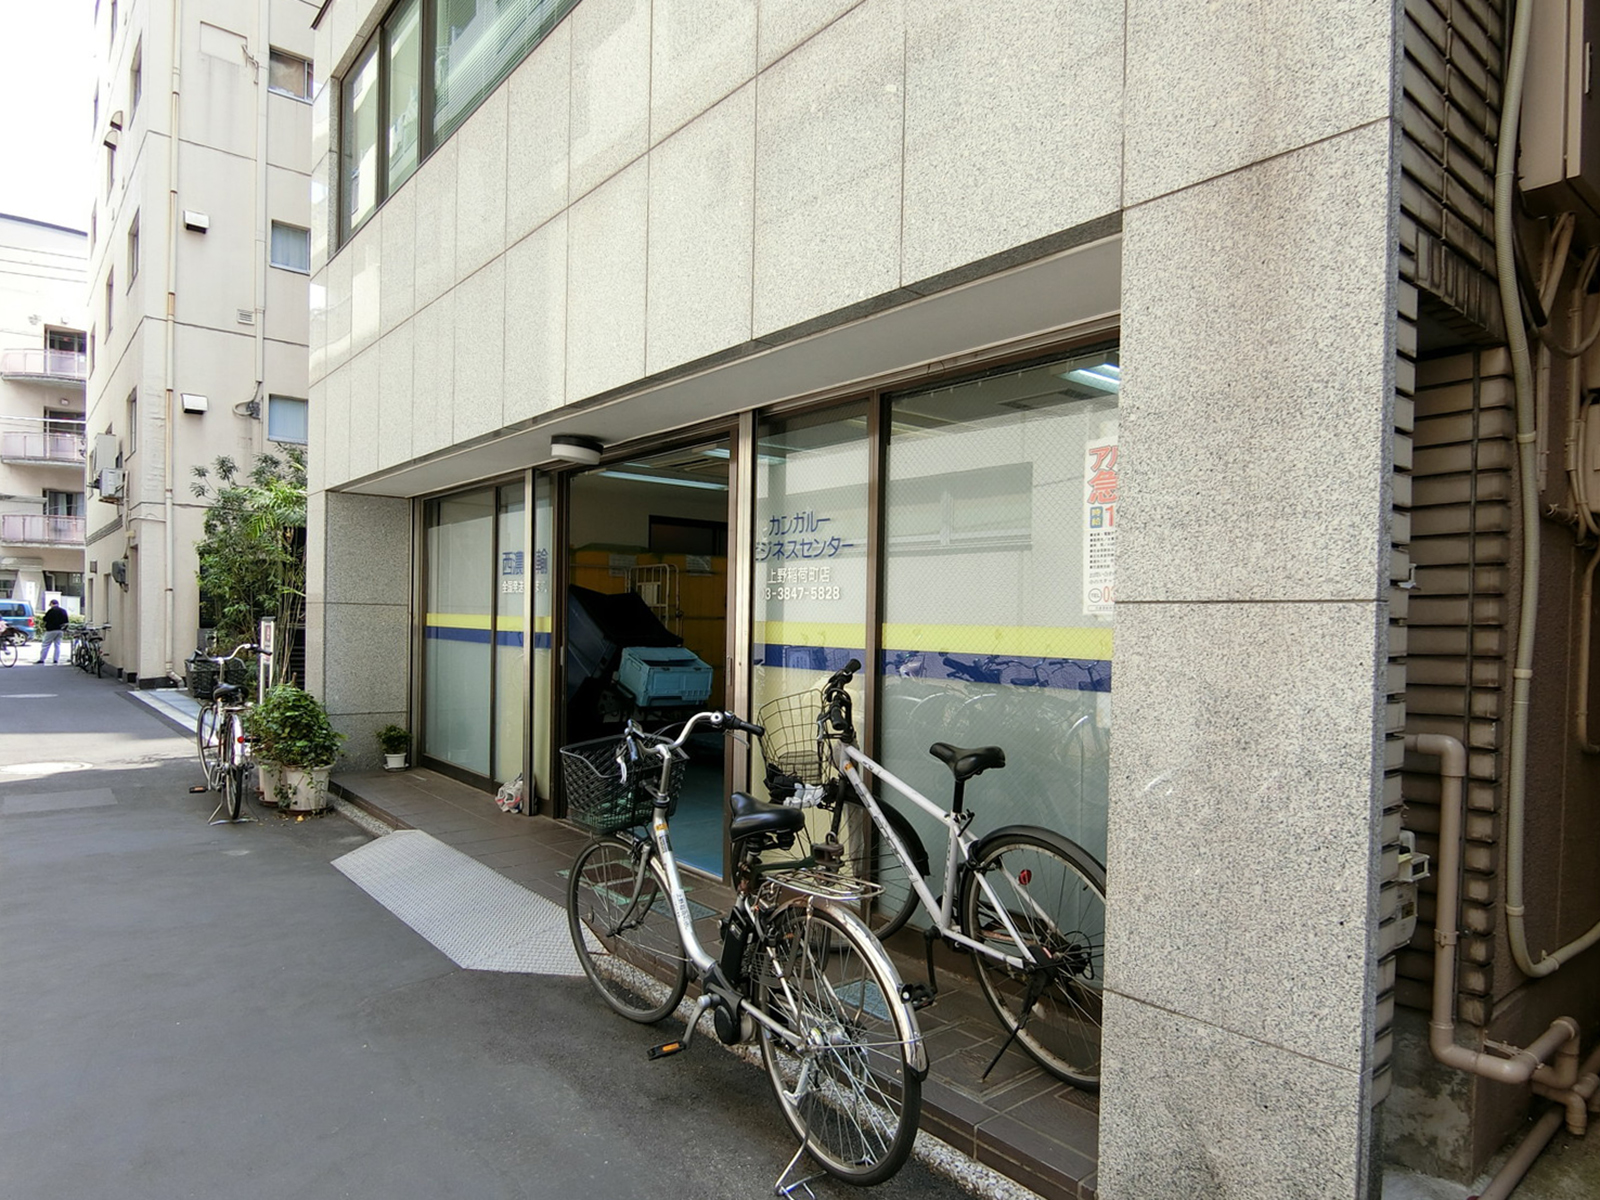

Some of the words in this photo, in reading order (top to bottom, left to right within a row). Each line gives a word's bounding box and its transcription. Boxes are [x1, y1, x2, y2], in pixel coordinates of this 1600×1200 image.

[769, 511, 831, 536] カンガルー
[755, 536, 854, 561] ジネスセンター
[502, 548, 548, 575] 西濃輸
[767, 566, 830, 584] 上野稲荷町店
